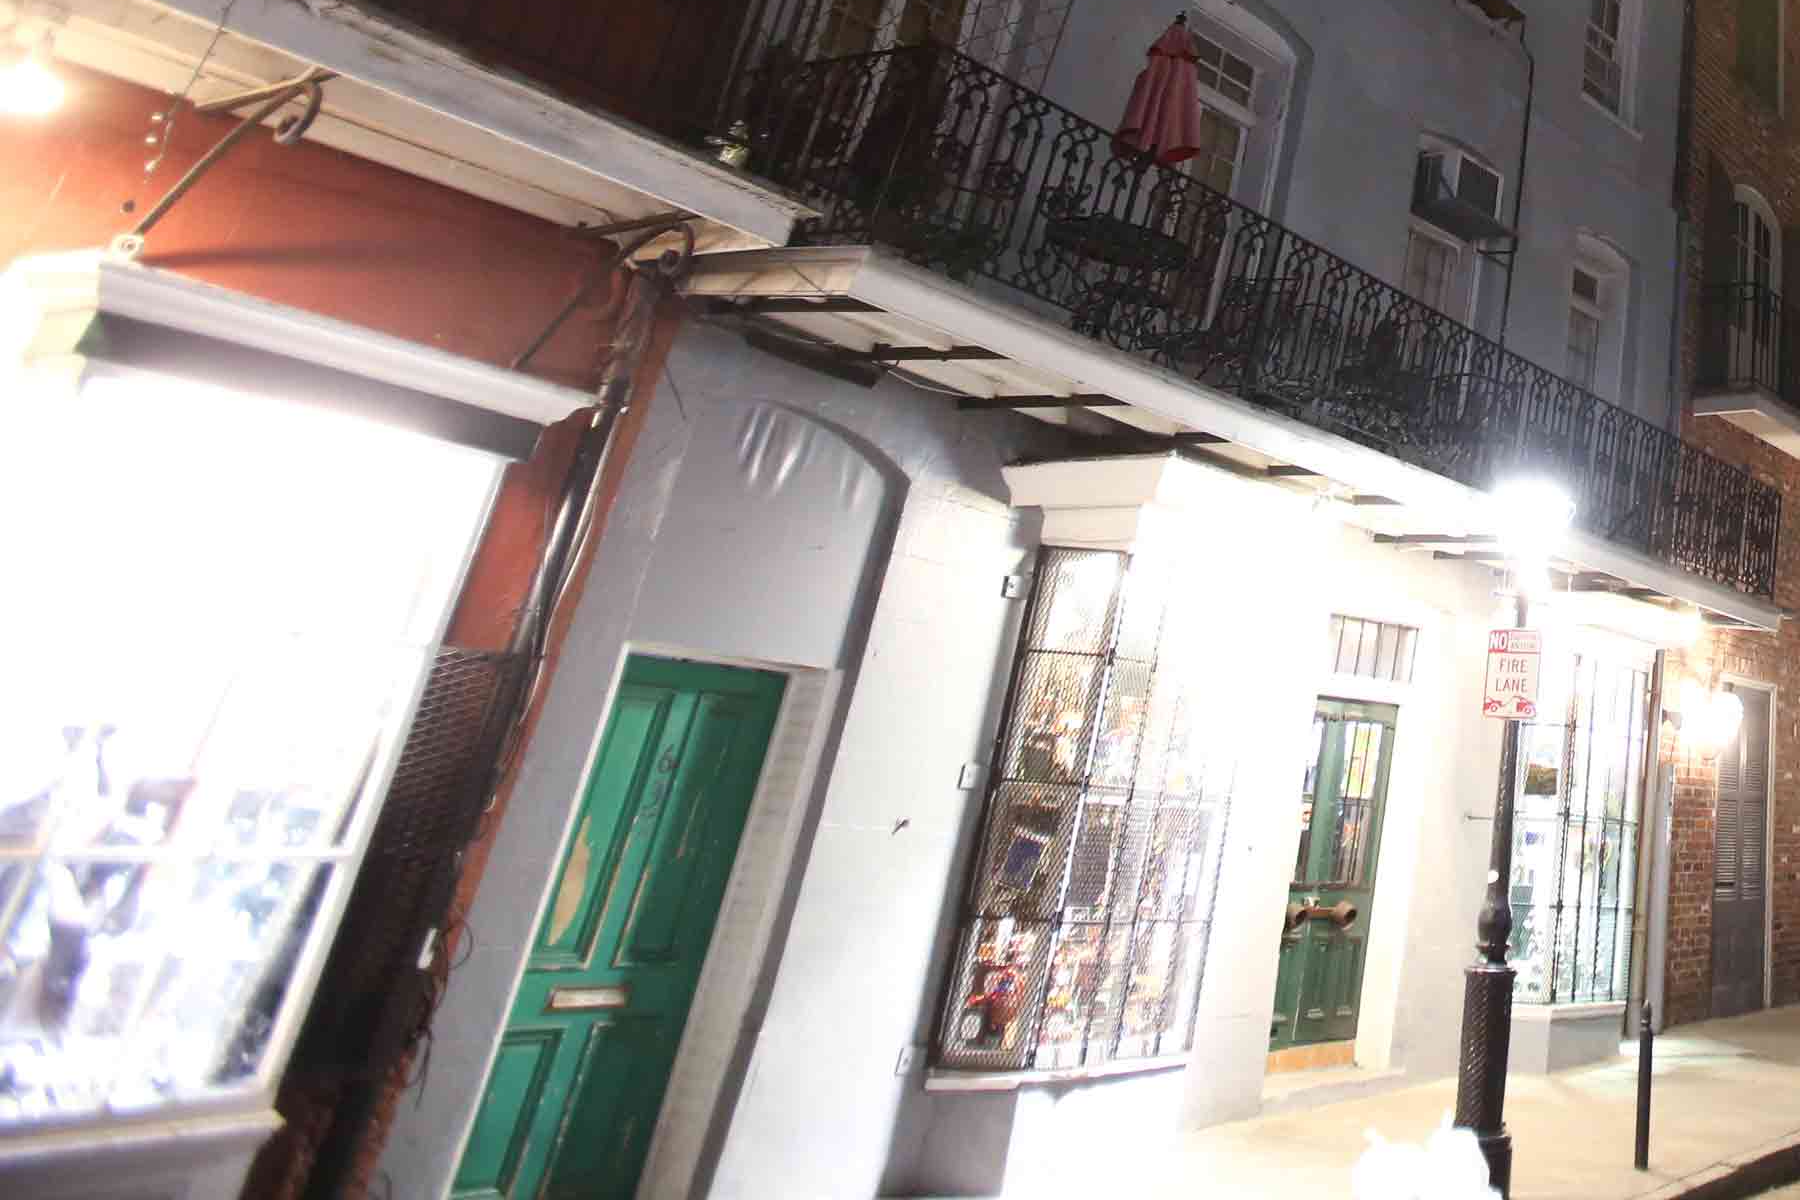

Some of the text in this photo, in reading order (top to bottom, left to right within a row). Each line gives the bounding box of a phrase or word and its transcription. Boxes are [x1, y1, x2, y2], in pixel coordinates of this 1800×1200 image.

[1489, 631, 1509, 650] NO
[1499, 658, 1528, 673] FIRE
[1496, 679, 1528, 693] LANE
